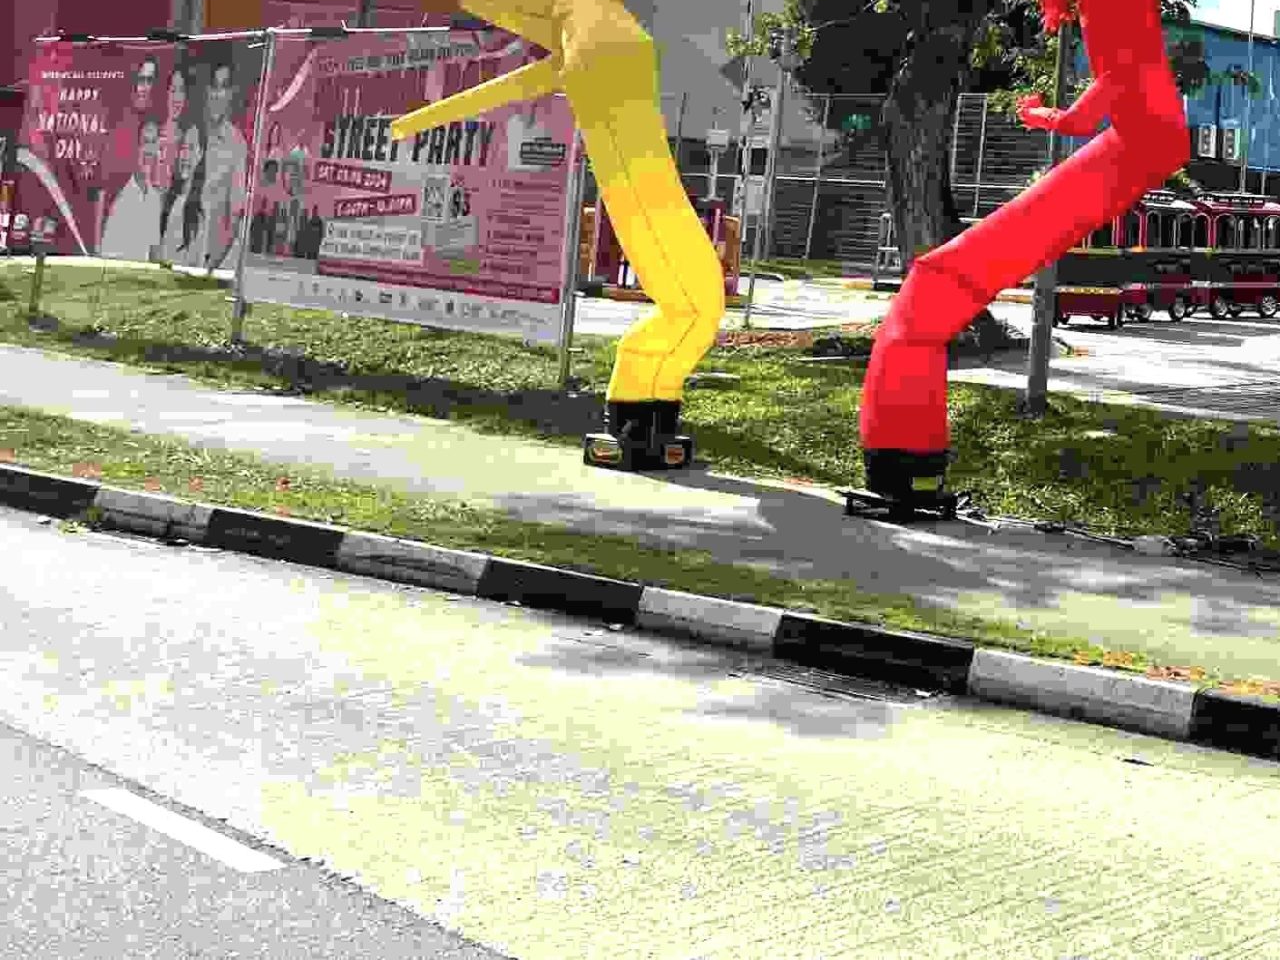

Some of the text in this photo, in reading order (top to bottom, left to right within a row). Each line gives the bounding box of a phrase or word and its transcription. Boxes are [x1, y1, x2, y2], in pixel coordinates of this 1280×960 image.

[58, 87, 101, 101] HAPPY
[38, 112, 109, 134] NATIONAL
[412, 121, 496, 166] PARTY
